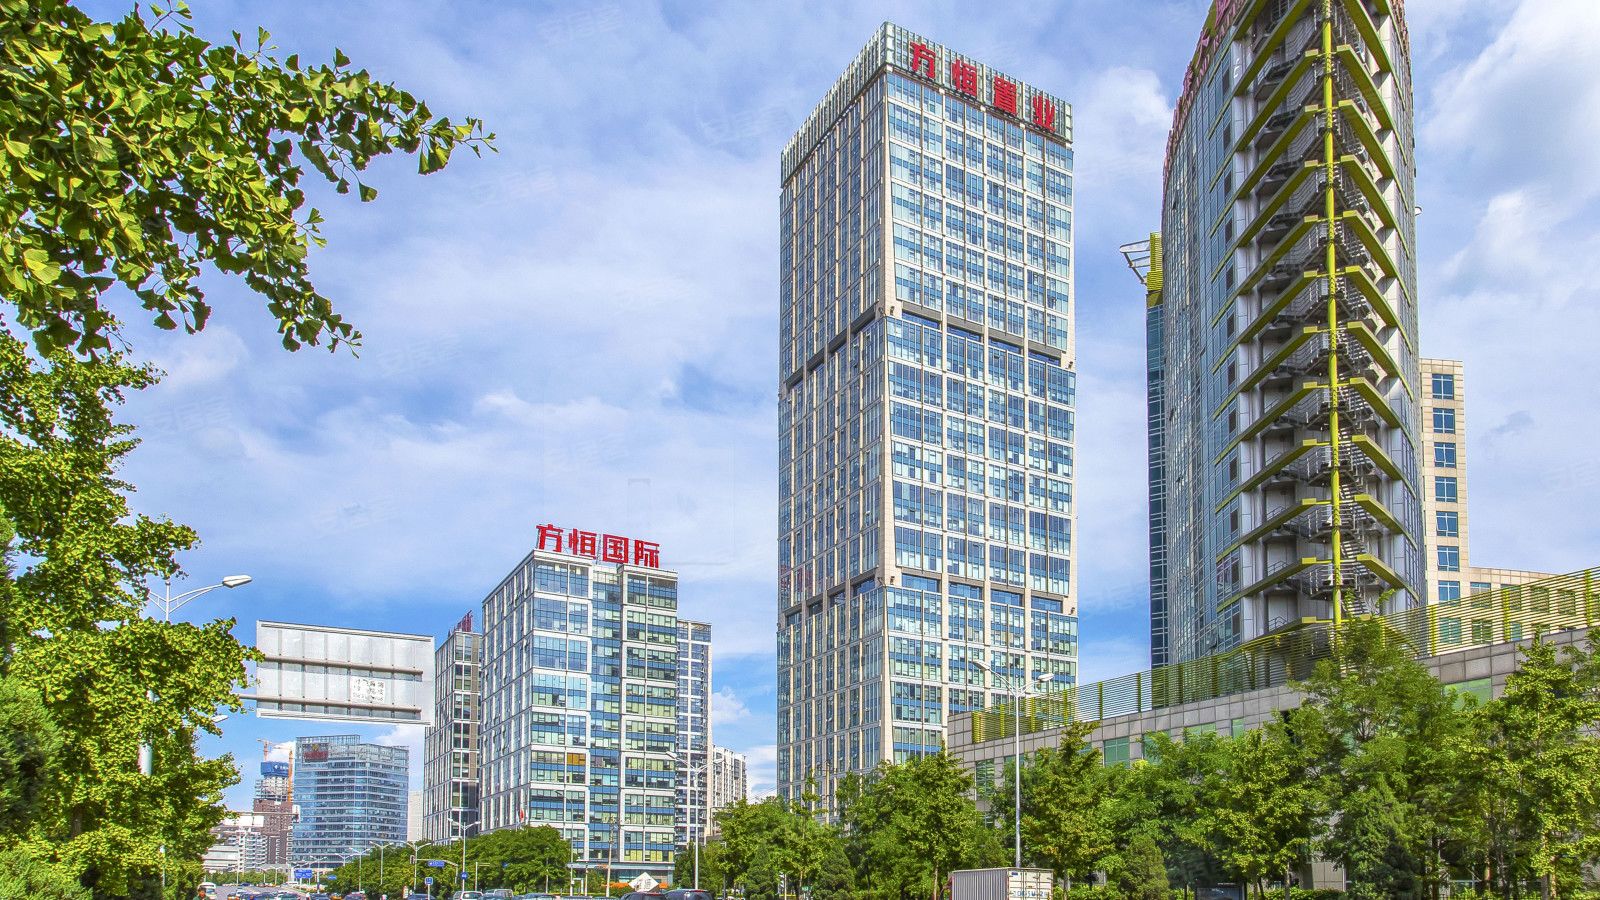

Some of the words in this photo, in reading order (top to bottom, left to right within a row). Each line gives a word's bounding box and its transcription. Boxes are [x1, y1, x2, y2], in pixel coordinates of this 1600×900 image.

[909, 41, 1056, 132] 方恒置业
[536, 523, 660, 569] 方恒国际
